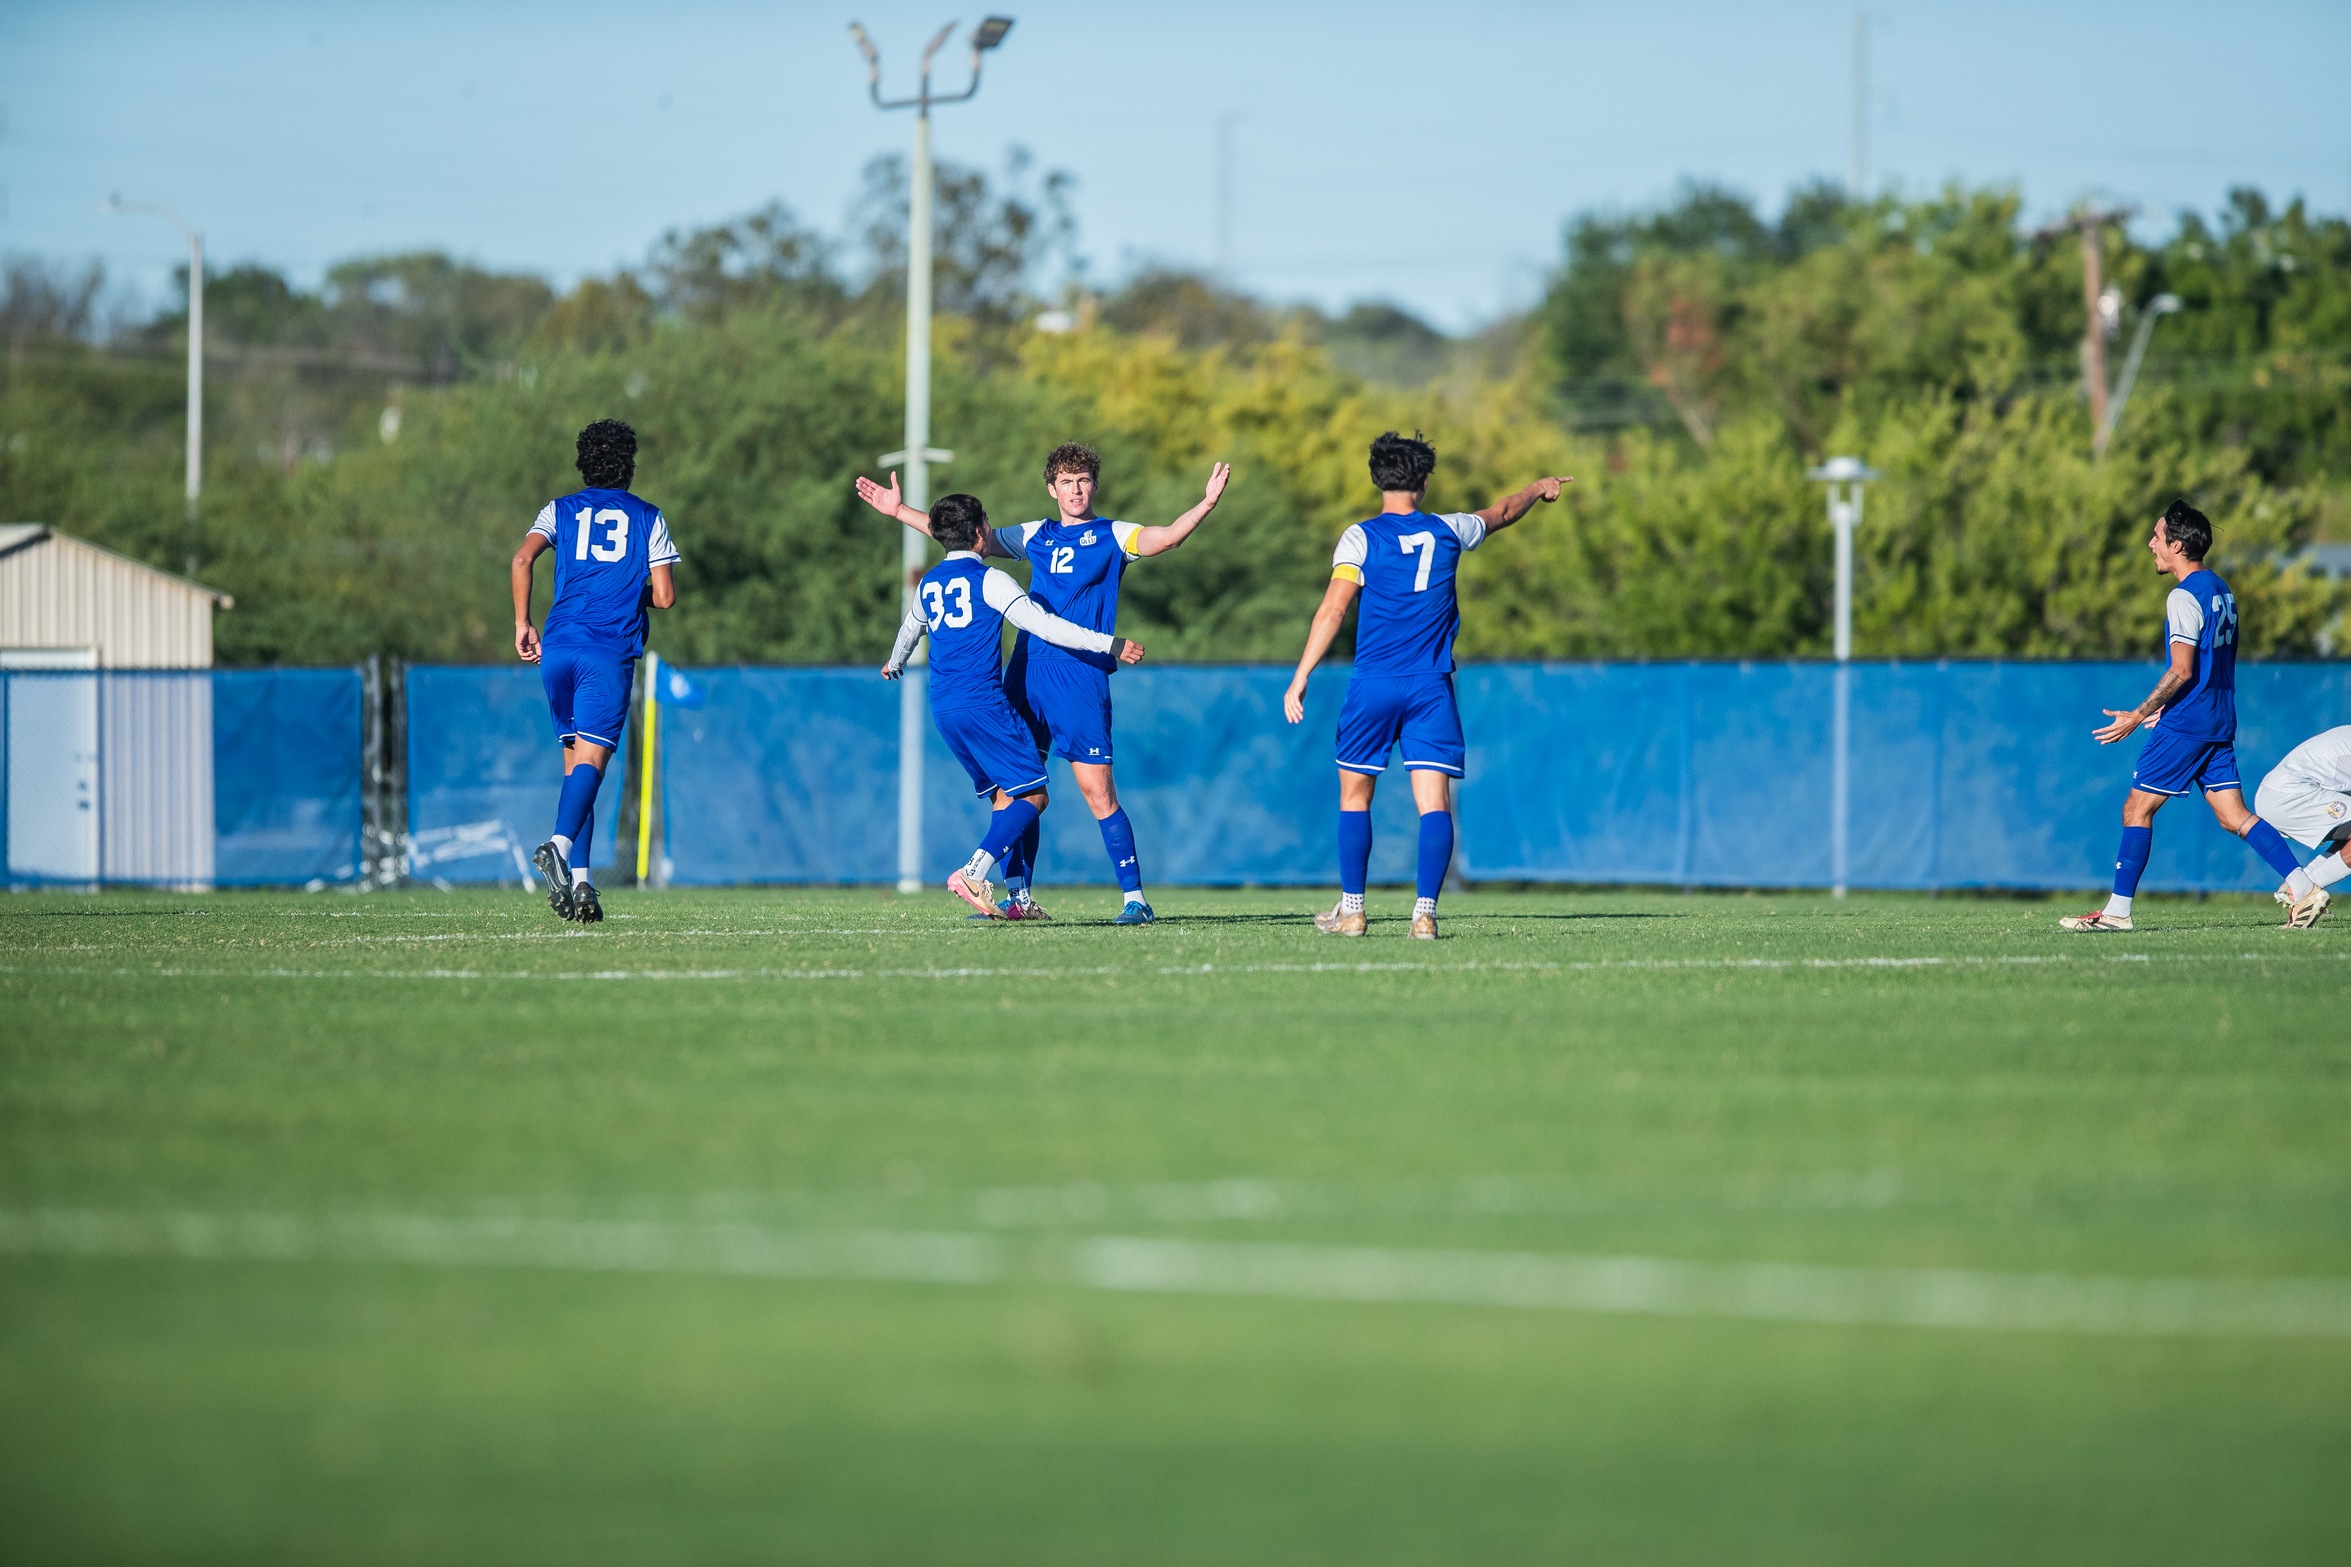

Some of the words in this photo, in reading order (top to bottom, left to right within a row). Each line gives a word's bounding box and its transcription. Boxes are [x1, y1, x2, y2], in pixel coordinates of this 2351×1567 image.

[575, 507, 629, 562] 13
[1050, 547, 1074, 573] 12
[1398, 531, 1436, 592] 7
[922, 577, 973, 632] 33
